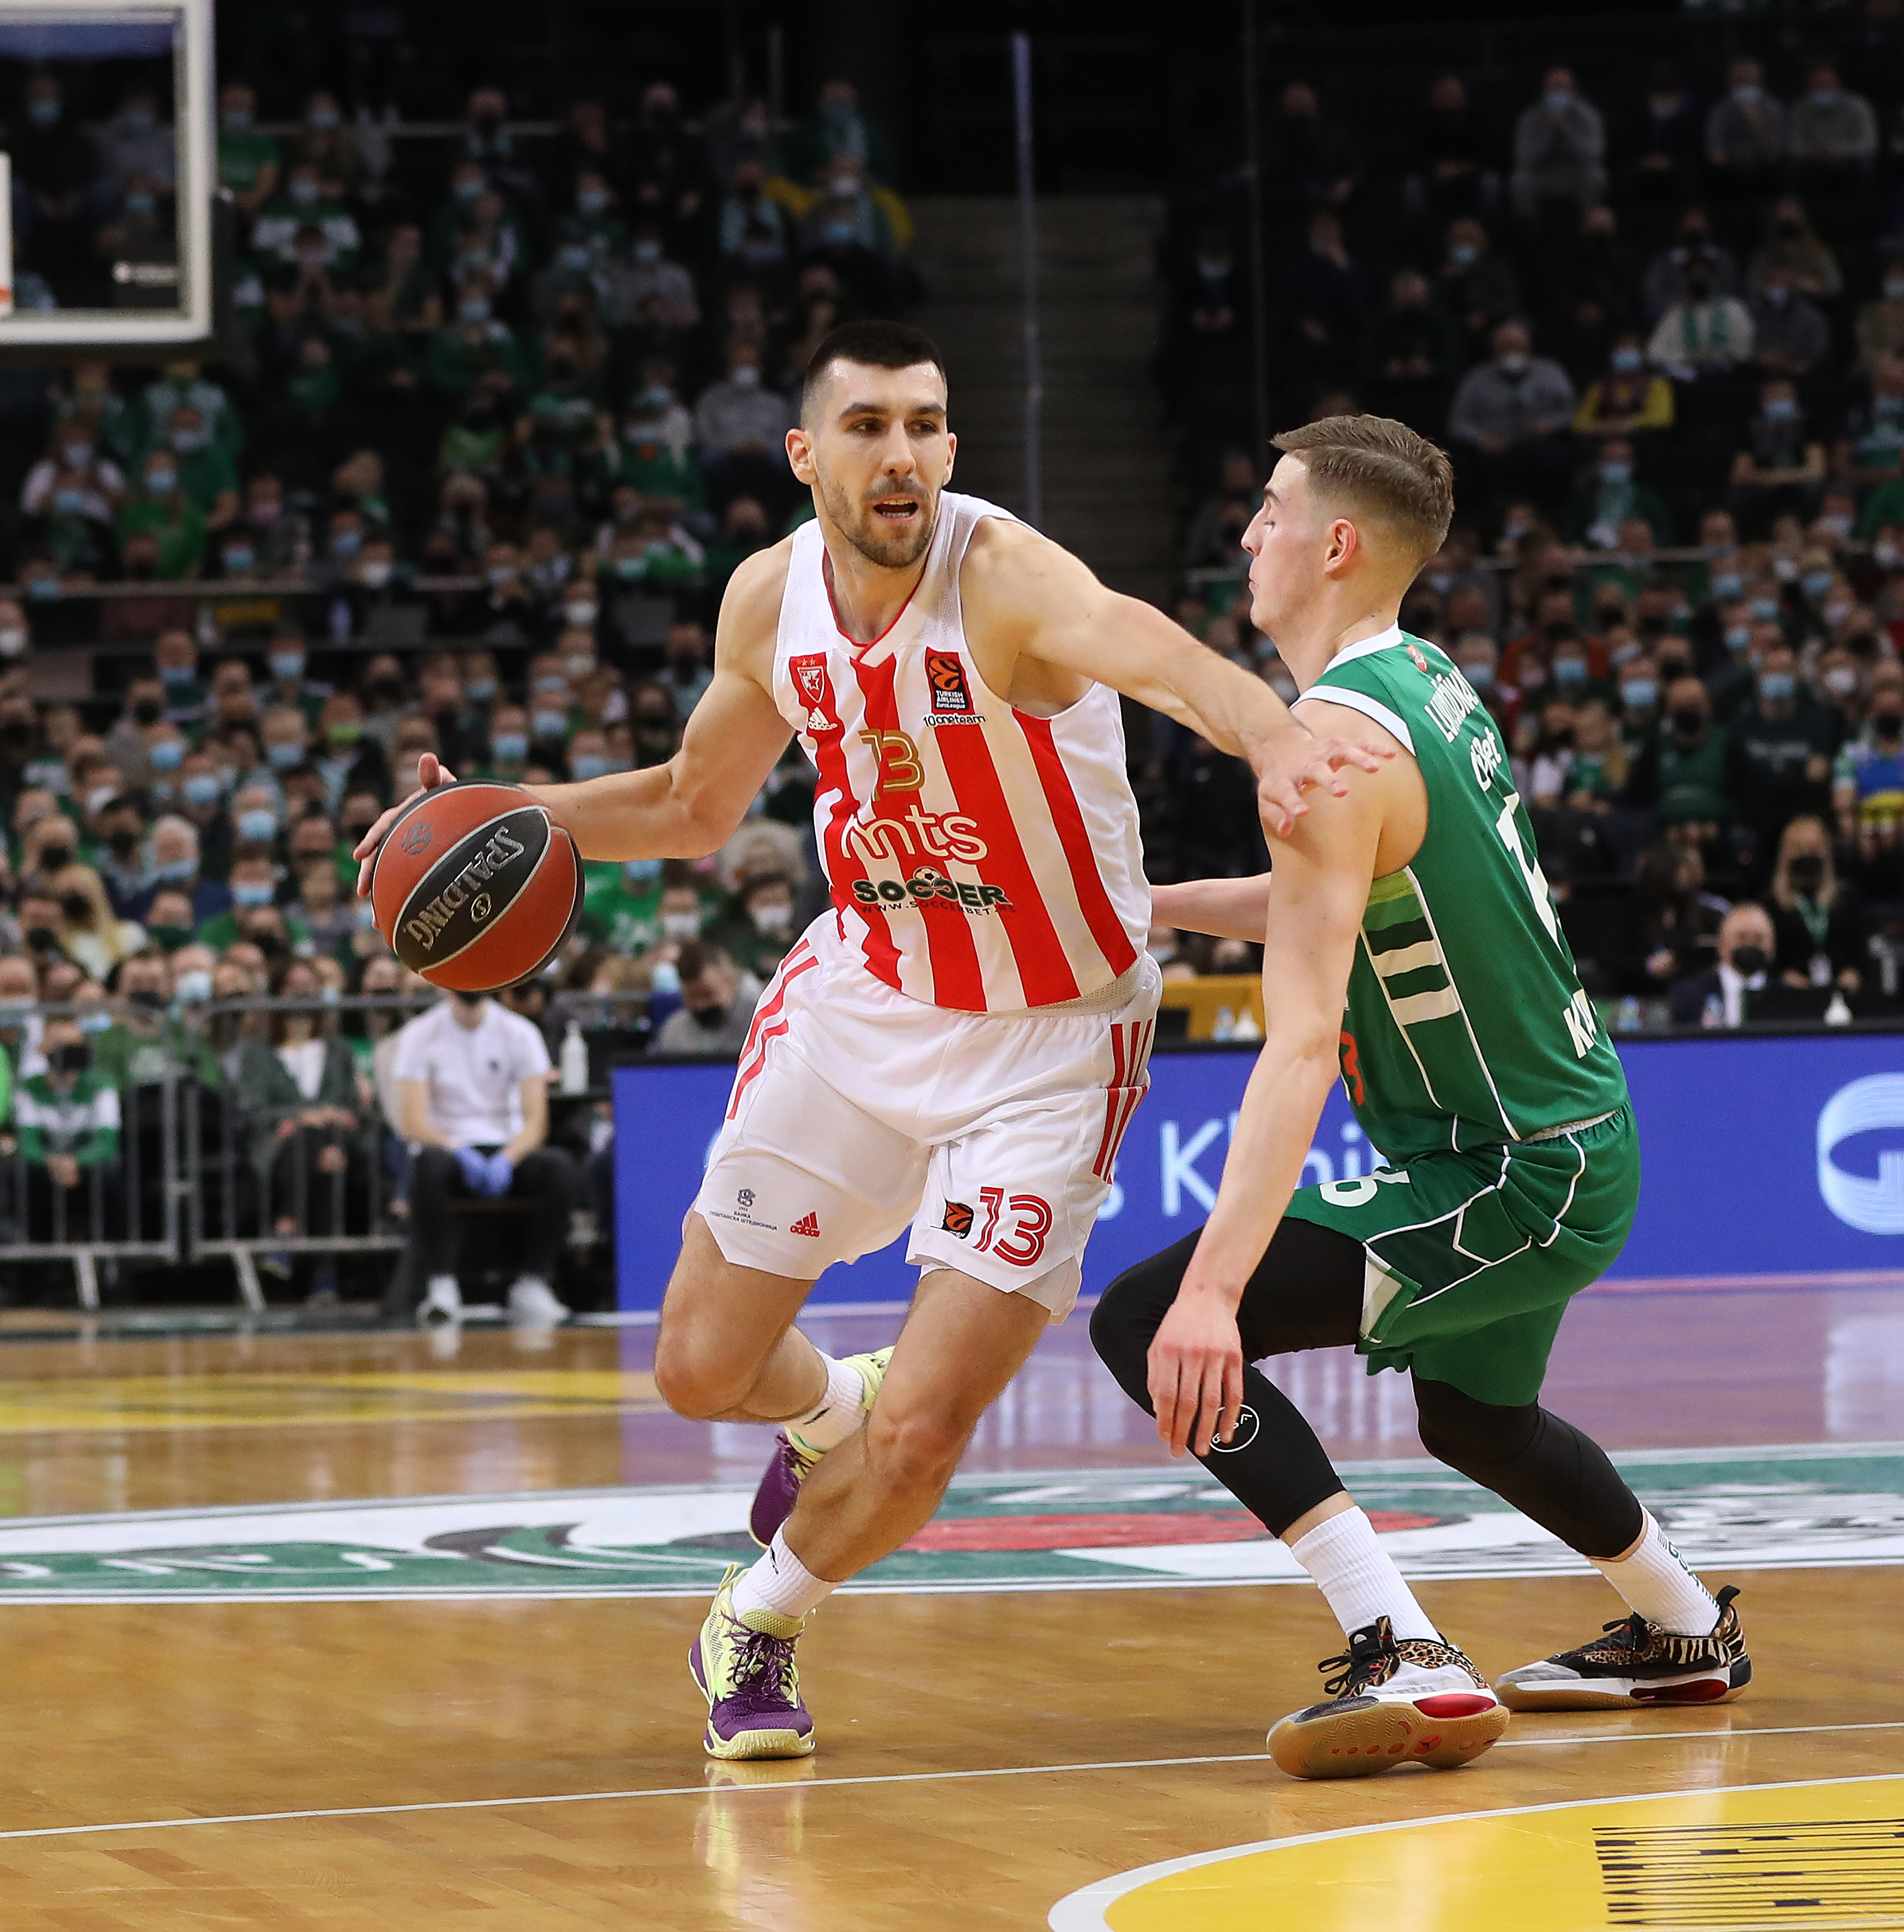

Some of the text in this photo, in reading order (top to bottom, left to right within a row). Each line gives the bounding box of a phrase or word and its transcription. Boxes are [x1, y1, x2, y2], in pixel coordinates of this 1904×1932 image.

[858, 729, 925, 801] 13
[840, 804, 989, 863] mts
[404, 826, 526, 951] SPALDING
[852, 878, 1013, 908] SOCCER
[972, 1186, 1053, 1267] 13
